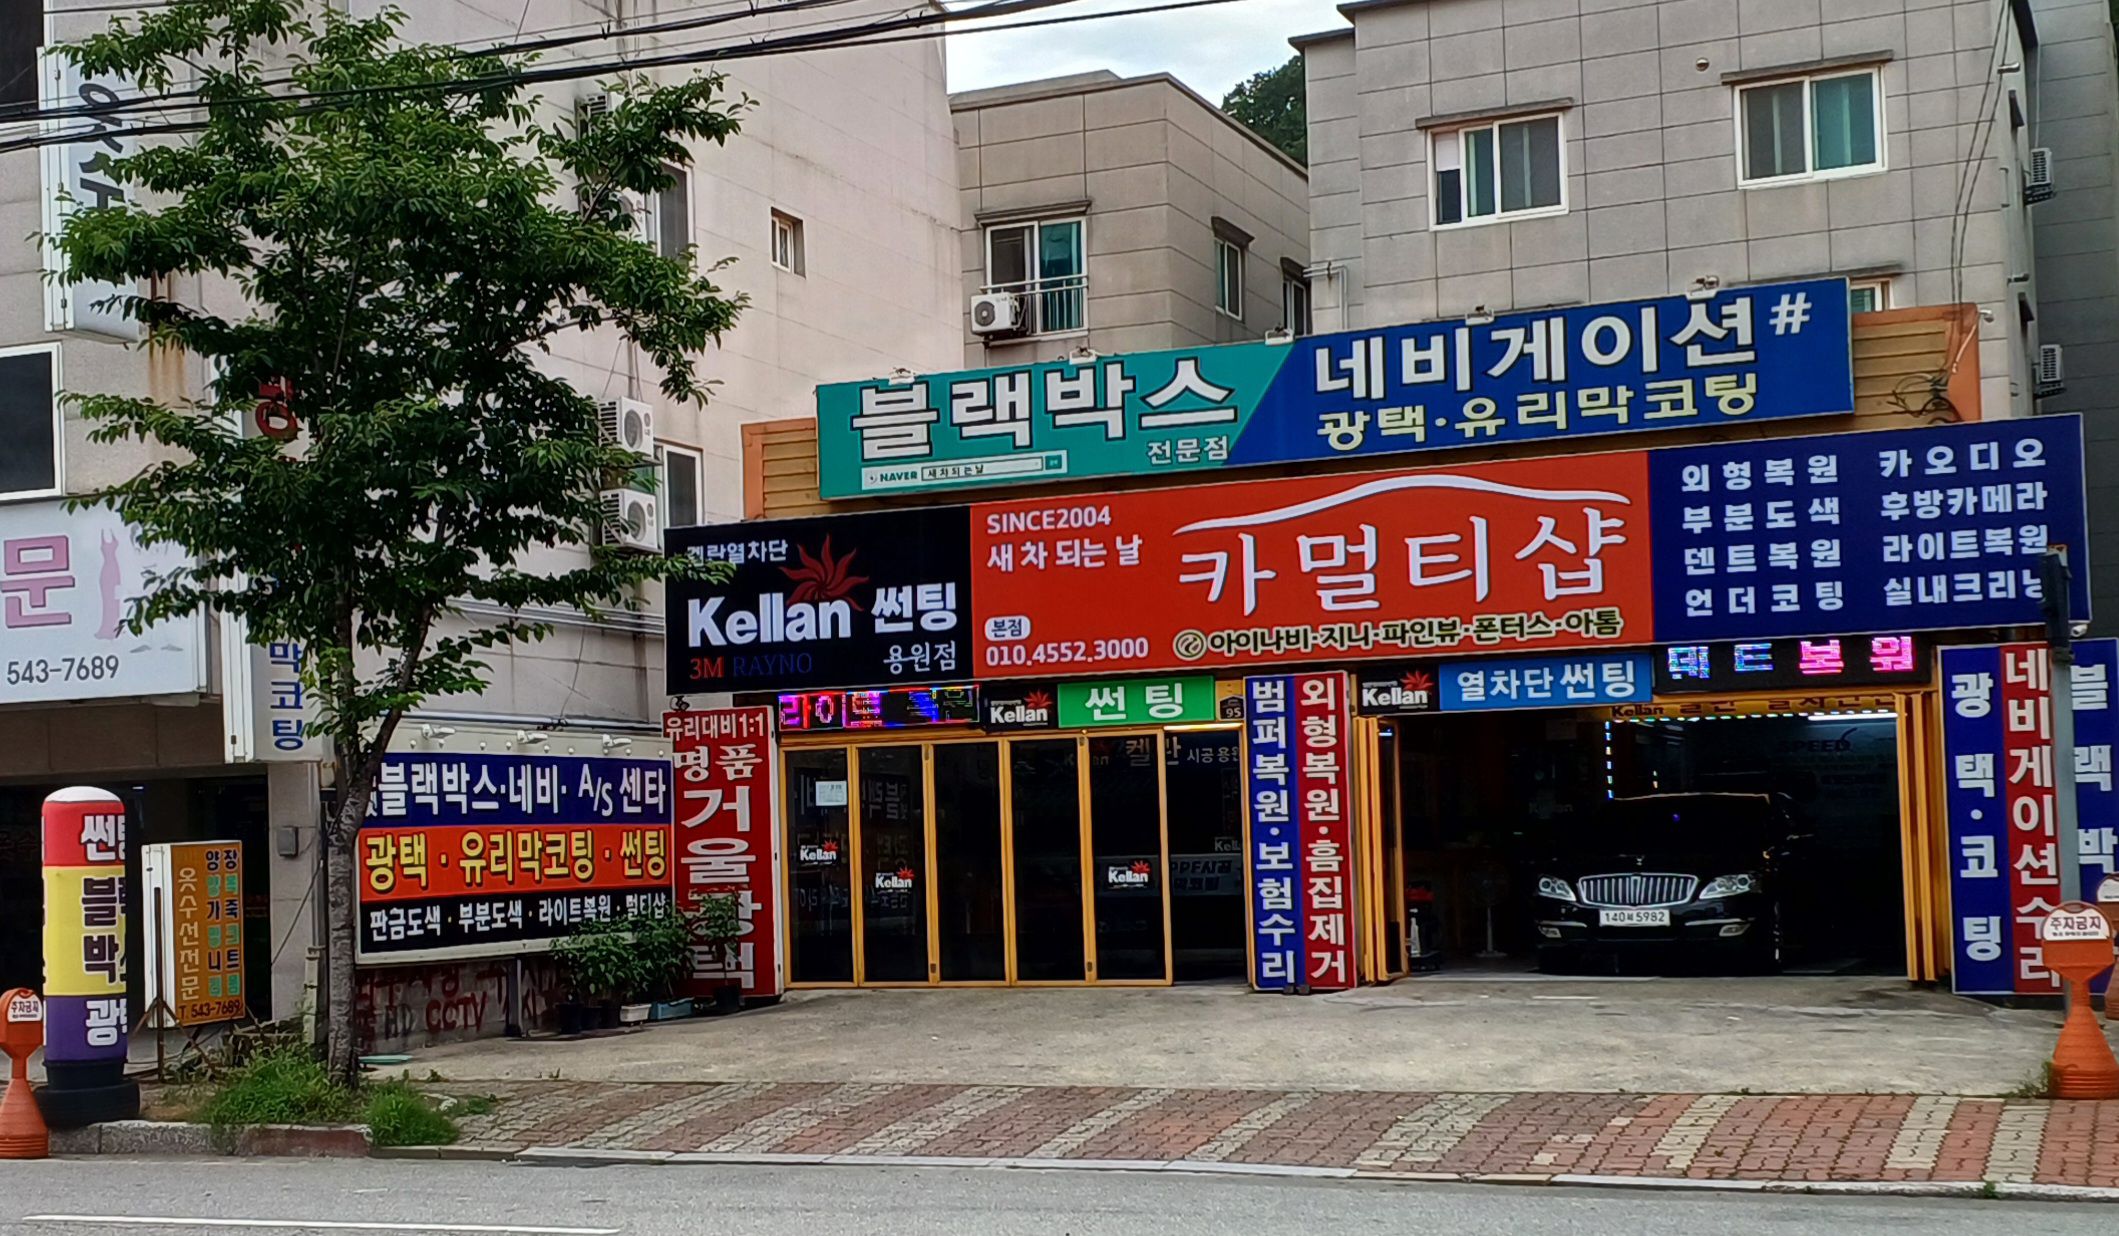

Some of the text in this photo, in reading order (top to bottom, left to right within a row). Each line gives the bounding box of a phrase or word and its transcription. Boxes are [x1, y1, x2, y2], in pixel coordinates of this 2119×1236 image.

[1315, 296, 1756, 400] 네비게이션
[851, 357, 1238, 461] 블랙박스
[1147, 437, 1229, 465] 전문점
[1879, 438, 2047, 479] 카오디오
[880, 471, 918, 482] NAVER
[1681, 455, 1839, 493] 외형복원
[987, 506, 1111, 534] SINCE2004
[1682, 497, 1841, 534] 부분도색
[1880, 482, 2048, 522] 후방카메라
[1178, 506, 1627, 617] 카멀티샵
[1684, 539, 1842, 575] 덴트복원
[1882, 525, 2048, 563] 라이트복원
[688, 582, 957, 647] Kellan 썬팅
[1685, 581, 1844, 617] 언더코팅
[991, 619, 1023, 638] 본점
[7, 655, 119, 686] 543-7689
[690, 652, 812, 679] 3M RAYNO
[884, 640, 956, 675] 용원점
[986, 637, 1149, 667] 010.4552.3000
[990, 705, 1048, 724] Kellan
[1085, 683, 1184, 722] 썬팅
[1362, 688, 1428, 707] Kellan
[674, 743, 763, 782] 명품
[2071, 663, 2118, 875] 블랙박
[578, 763, 613, 818] A/S
[620, 769, 667, 815] 센타
[365, 829, 667, 892] 광택 유리막코팅 썬팅
[800, 845, 837, 861] Kellan
[875, 875, 913, 889] Kellan
[1108, 868, 1148, 884] Kellan
[82, 876, 125, 927] 블
[370, 904, 441, 942] 판금도색
[459, 900, 523, 933] 부분도색
[538, 894, 612, 926] 라이트복원
[82, 934, 125, 984] 박
[86, 998, 127, 1046] 광
